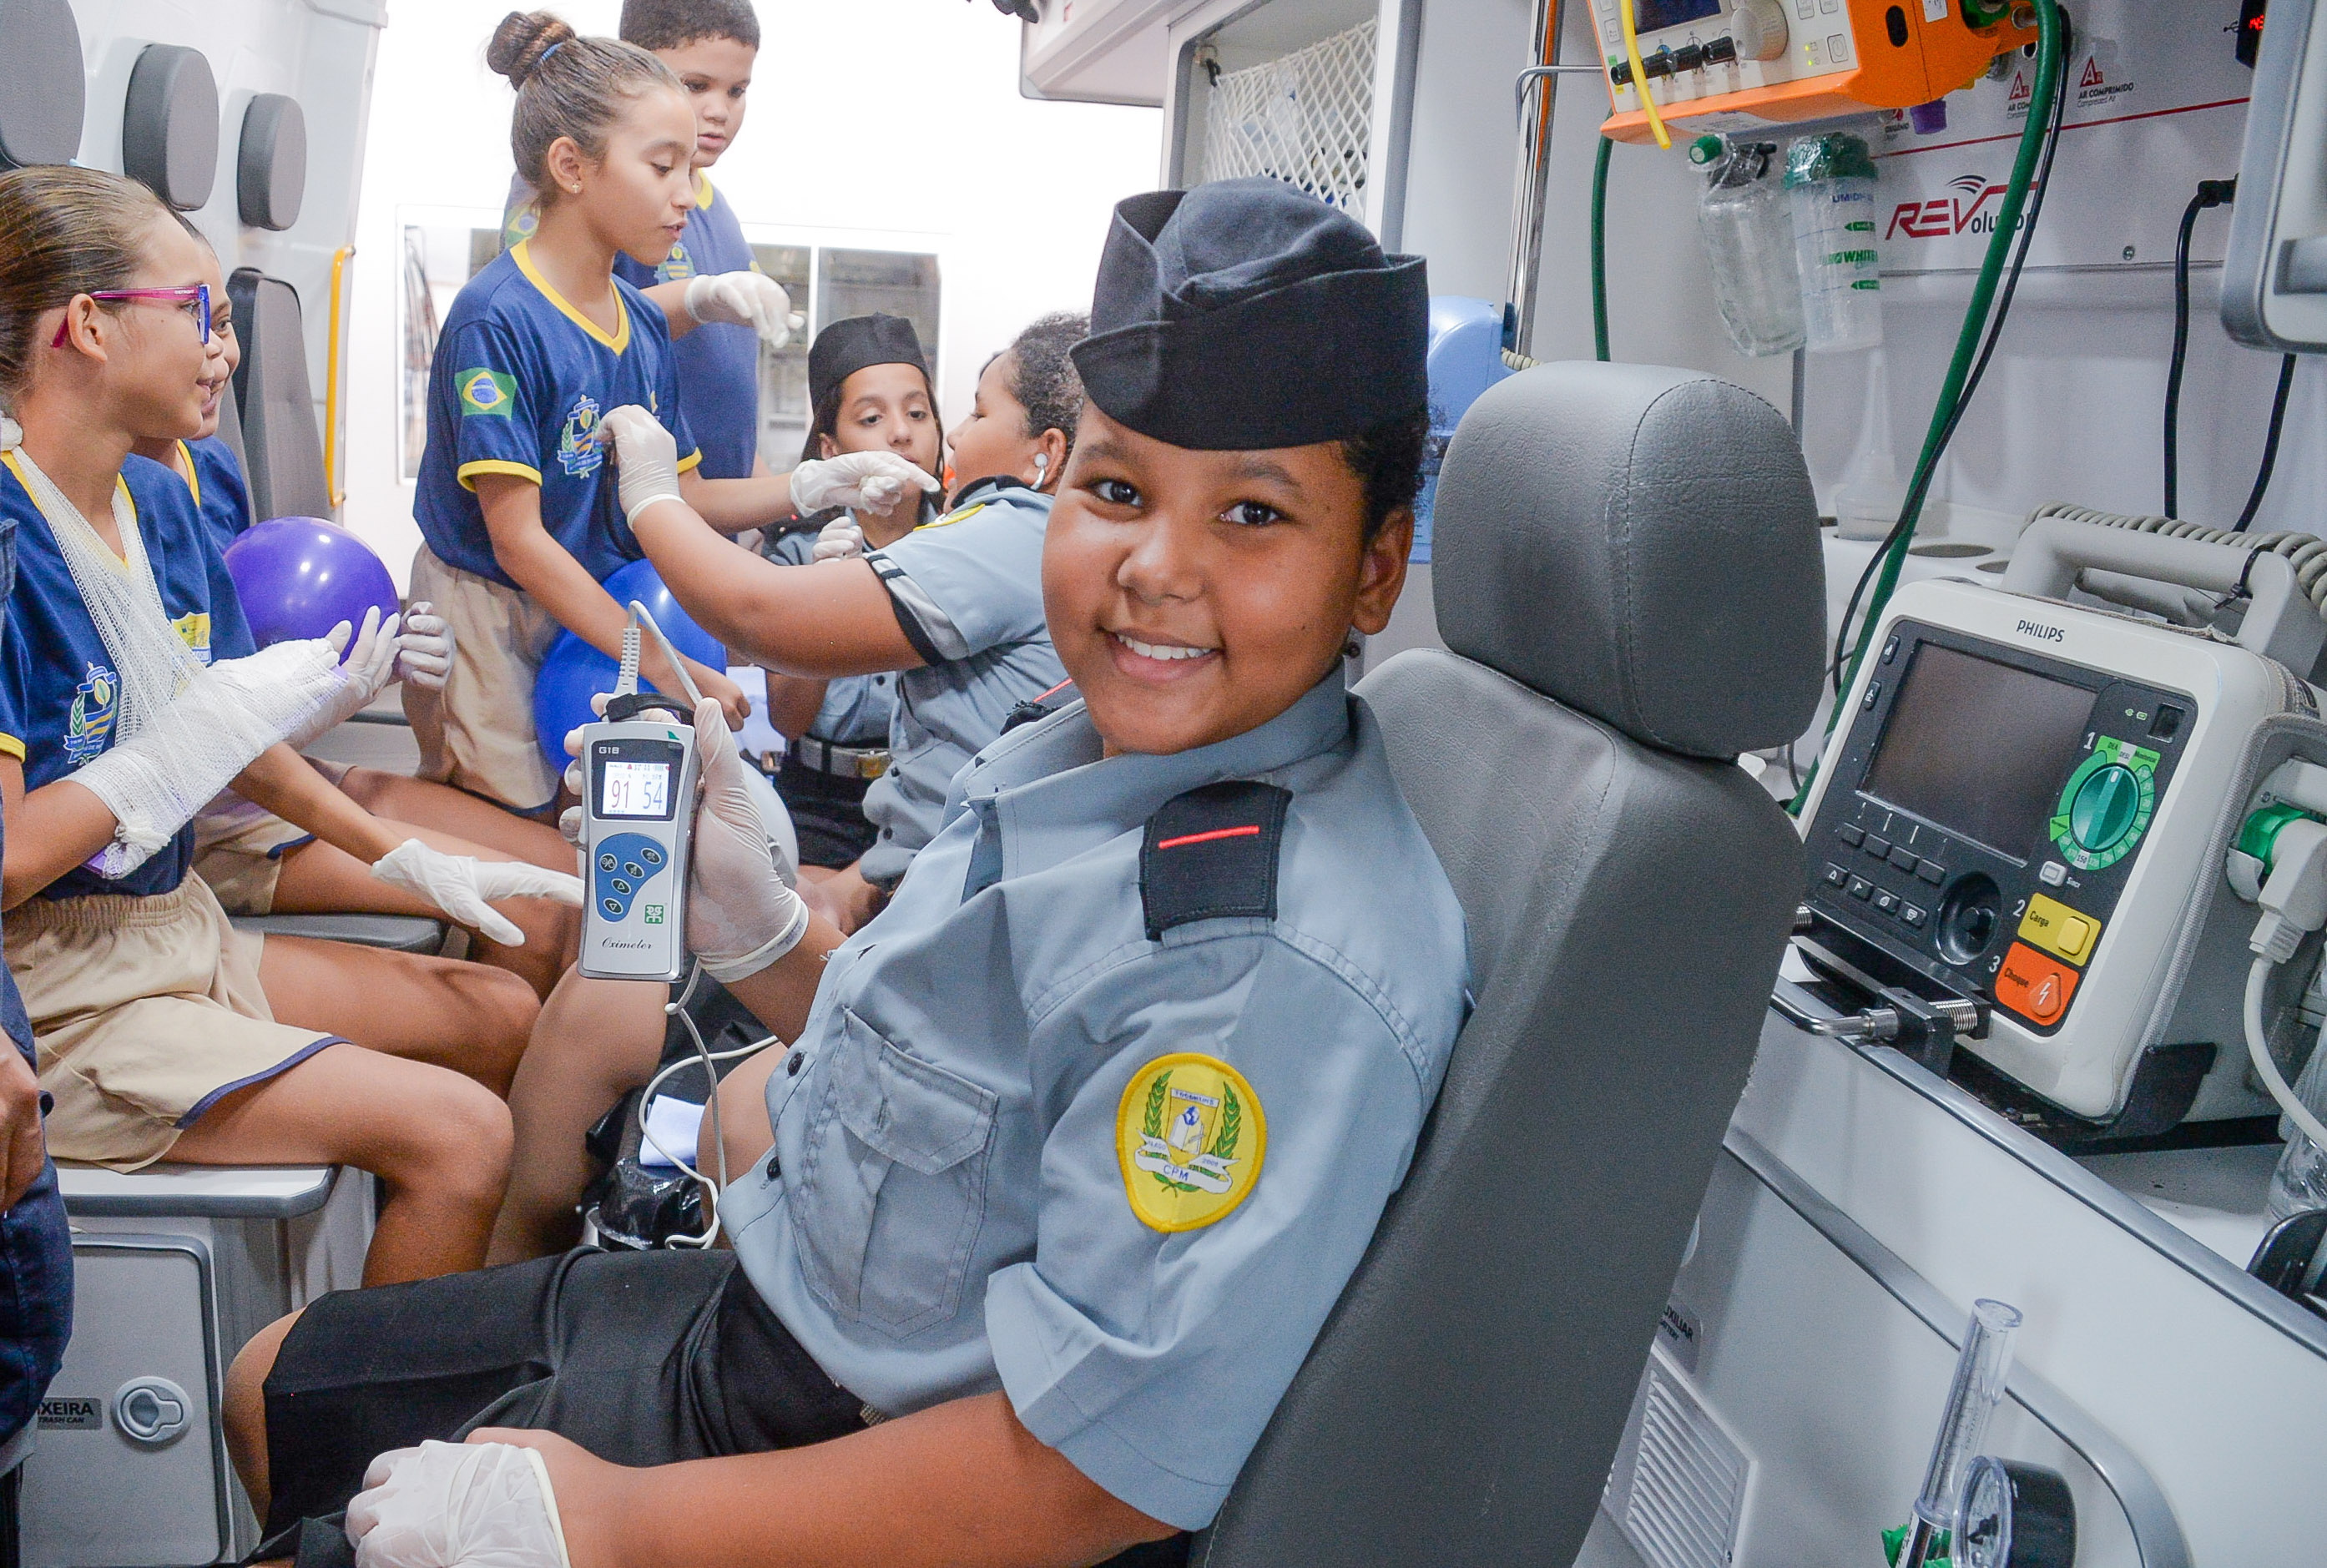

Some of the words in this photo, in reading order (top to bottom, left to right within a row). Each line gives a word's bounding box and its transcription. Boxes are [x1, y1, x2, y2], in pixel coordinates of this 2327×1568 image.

[2078, 91, 2087, 99] AR
[2089, 82, 2134, 98] COMPRIMIDO
[2016, 619, 2065, 643] PHILIPS
[2083, 732, 2096, 749] 1
[612, 779, 629, 809] 91
[643, 781, 663, 809] 54
[2077, 855, 2087, 864] 150
[2012, 899, 2026, 917] 2
[2029, 910, 2049, 928] Carga
[602, 936, 652, 950] Oximeter
[1988, 955, 2001, 973] 3
[2004, 967, 2030, 988] Choque
[1163, 1164, 1189, 1182] CPM
